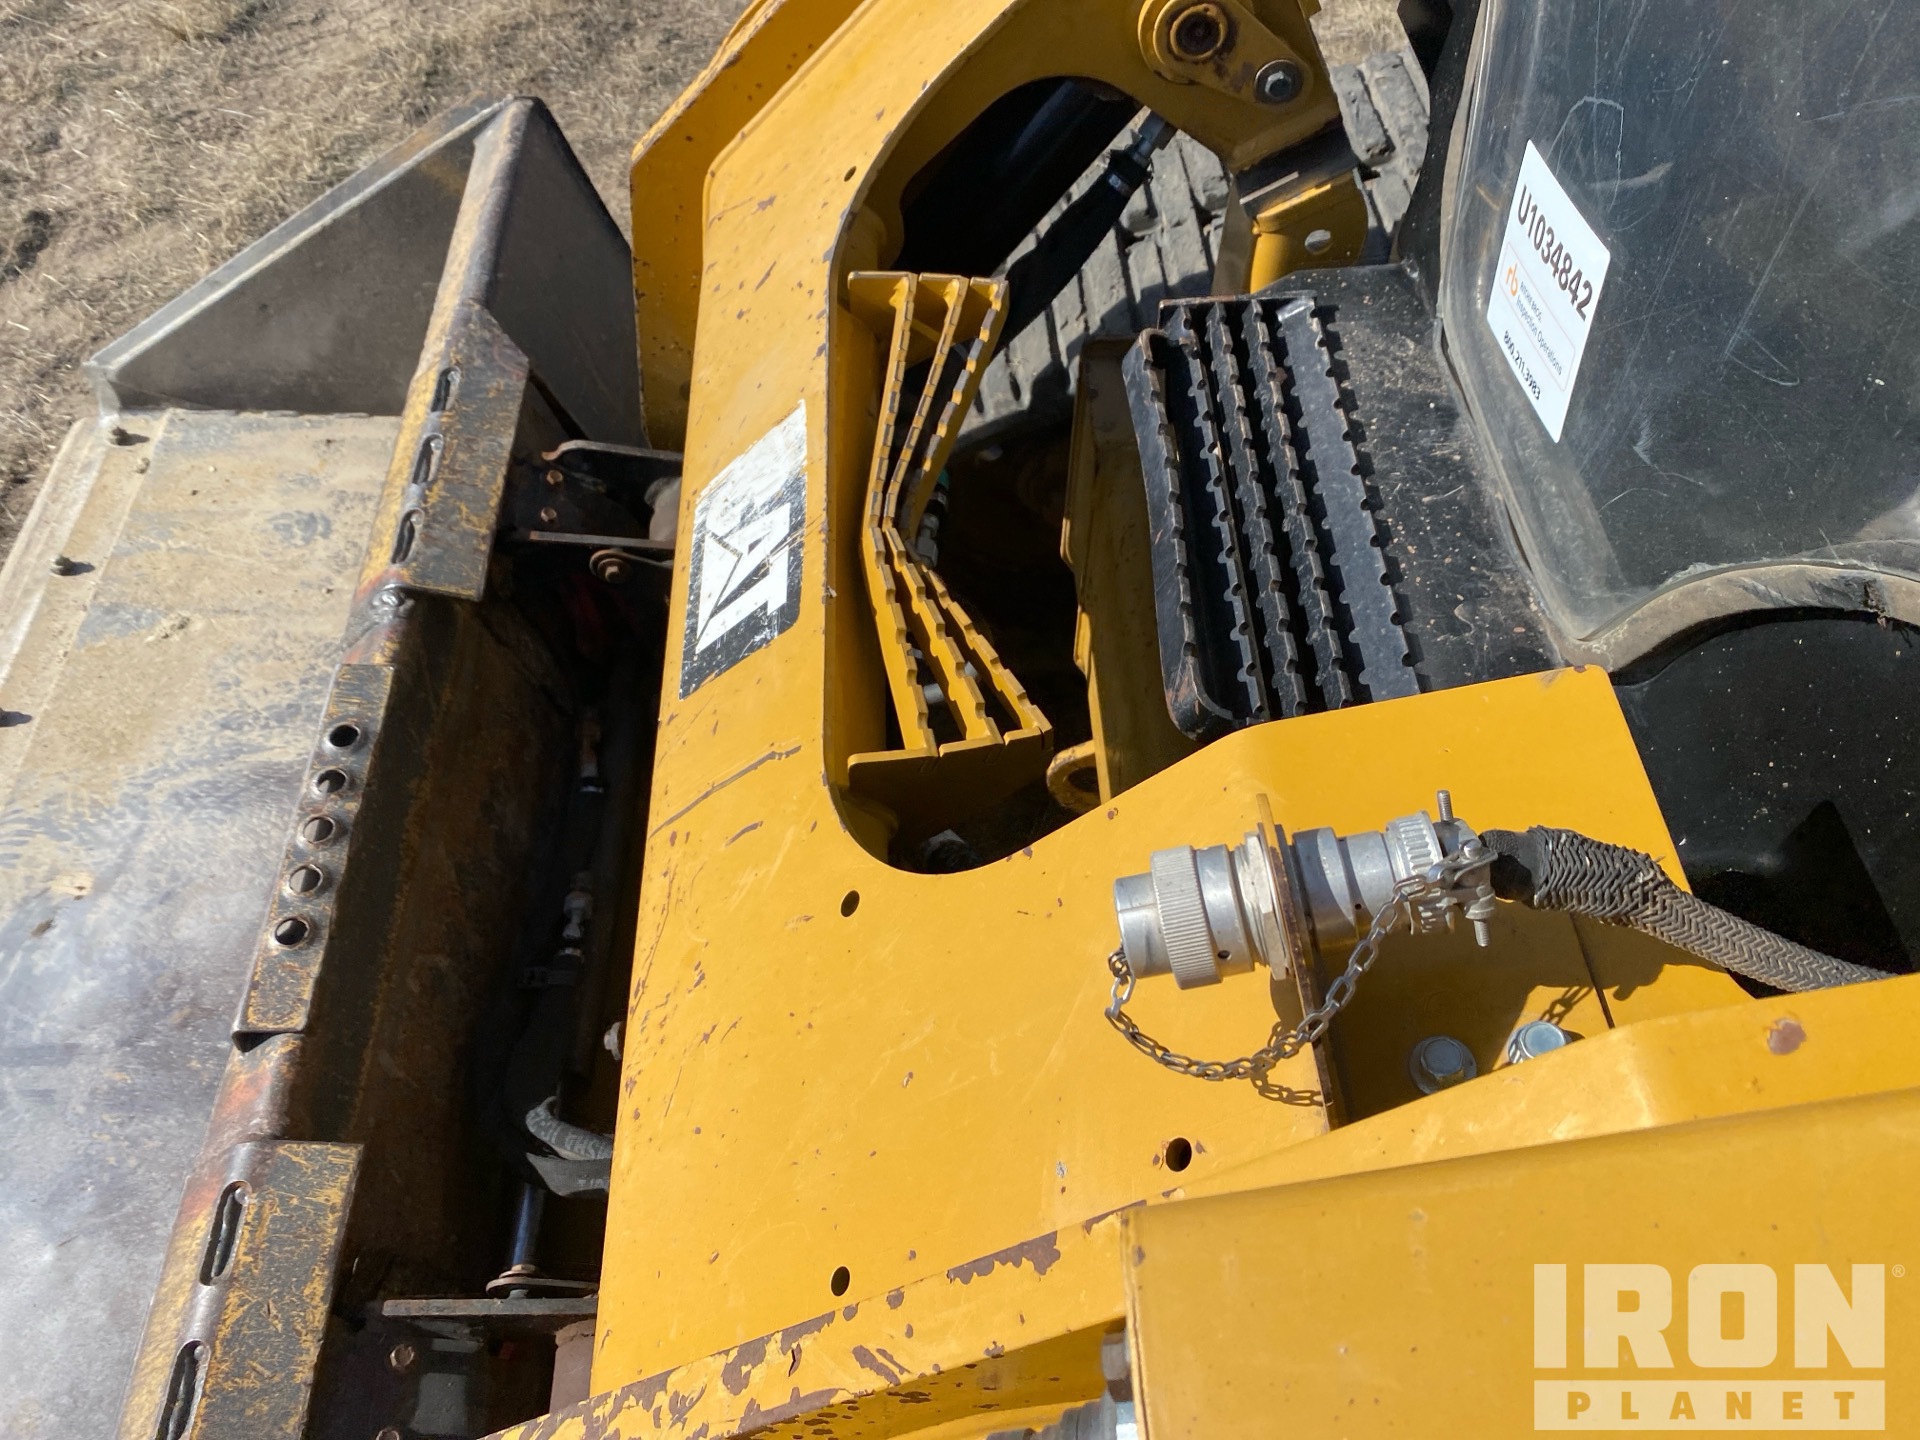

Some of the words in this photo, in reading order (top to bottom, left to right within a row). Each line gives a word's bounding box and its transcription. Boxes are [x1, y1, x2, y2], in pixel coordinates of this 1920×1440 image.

[1517, 184, 1594, 321] U1034842
[1516, 295, 1538, 338] Inspection
[1537, 331, 1563, 376] Operations
